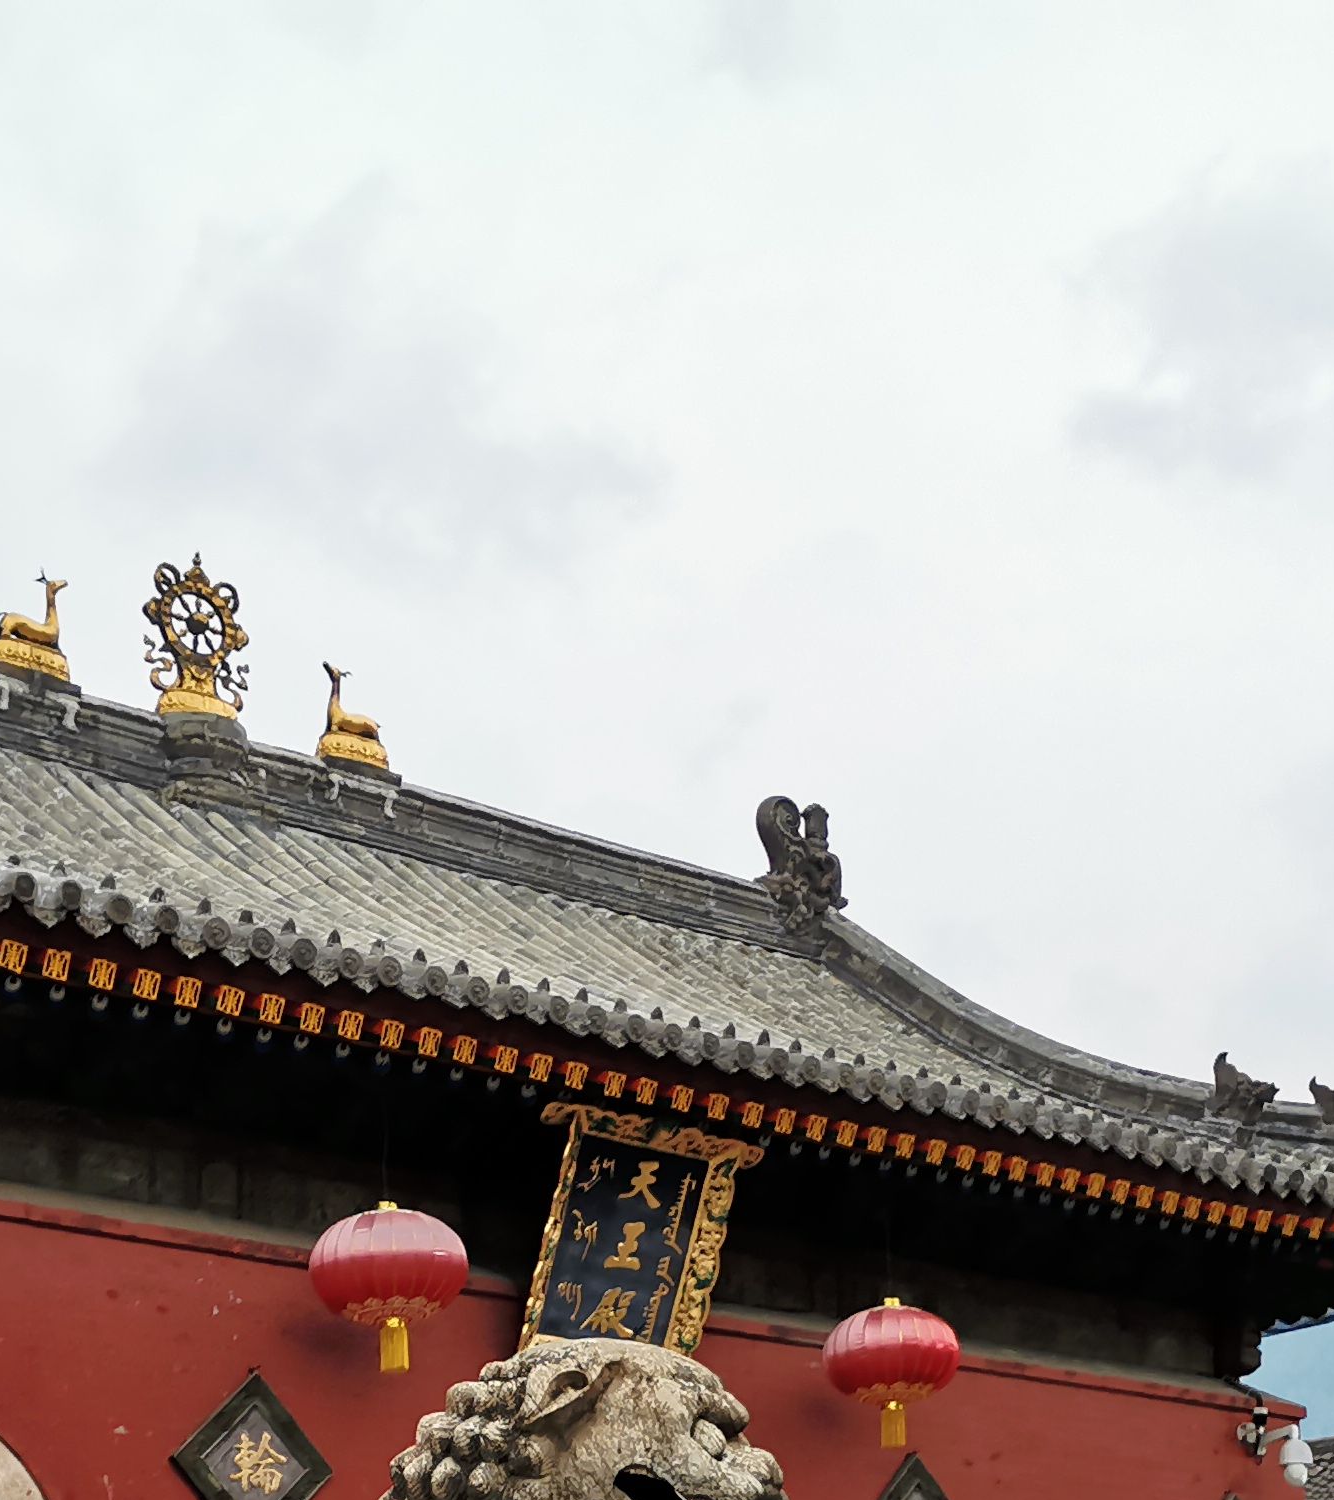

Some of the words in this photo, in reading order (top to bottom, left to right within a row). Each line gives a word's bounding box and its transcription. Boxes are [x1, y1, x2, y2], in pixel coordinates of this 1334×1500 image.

[578, 1160, 662, 1339] 天王殿
[228, 1431, 289, 1495] 輪
